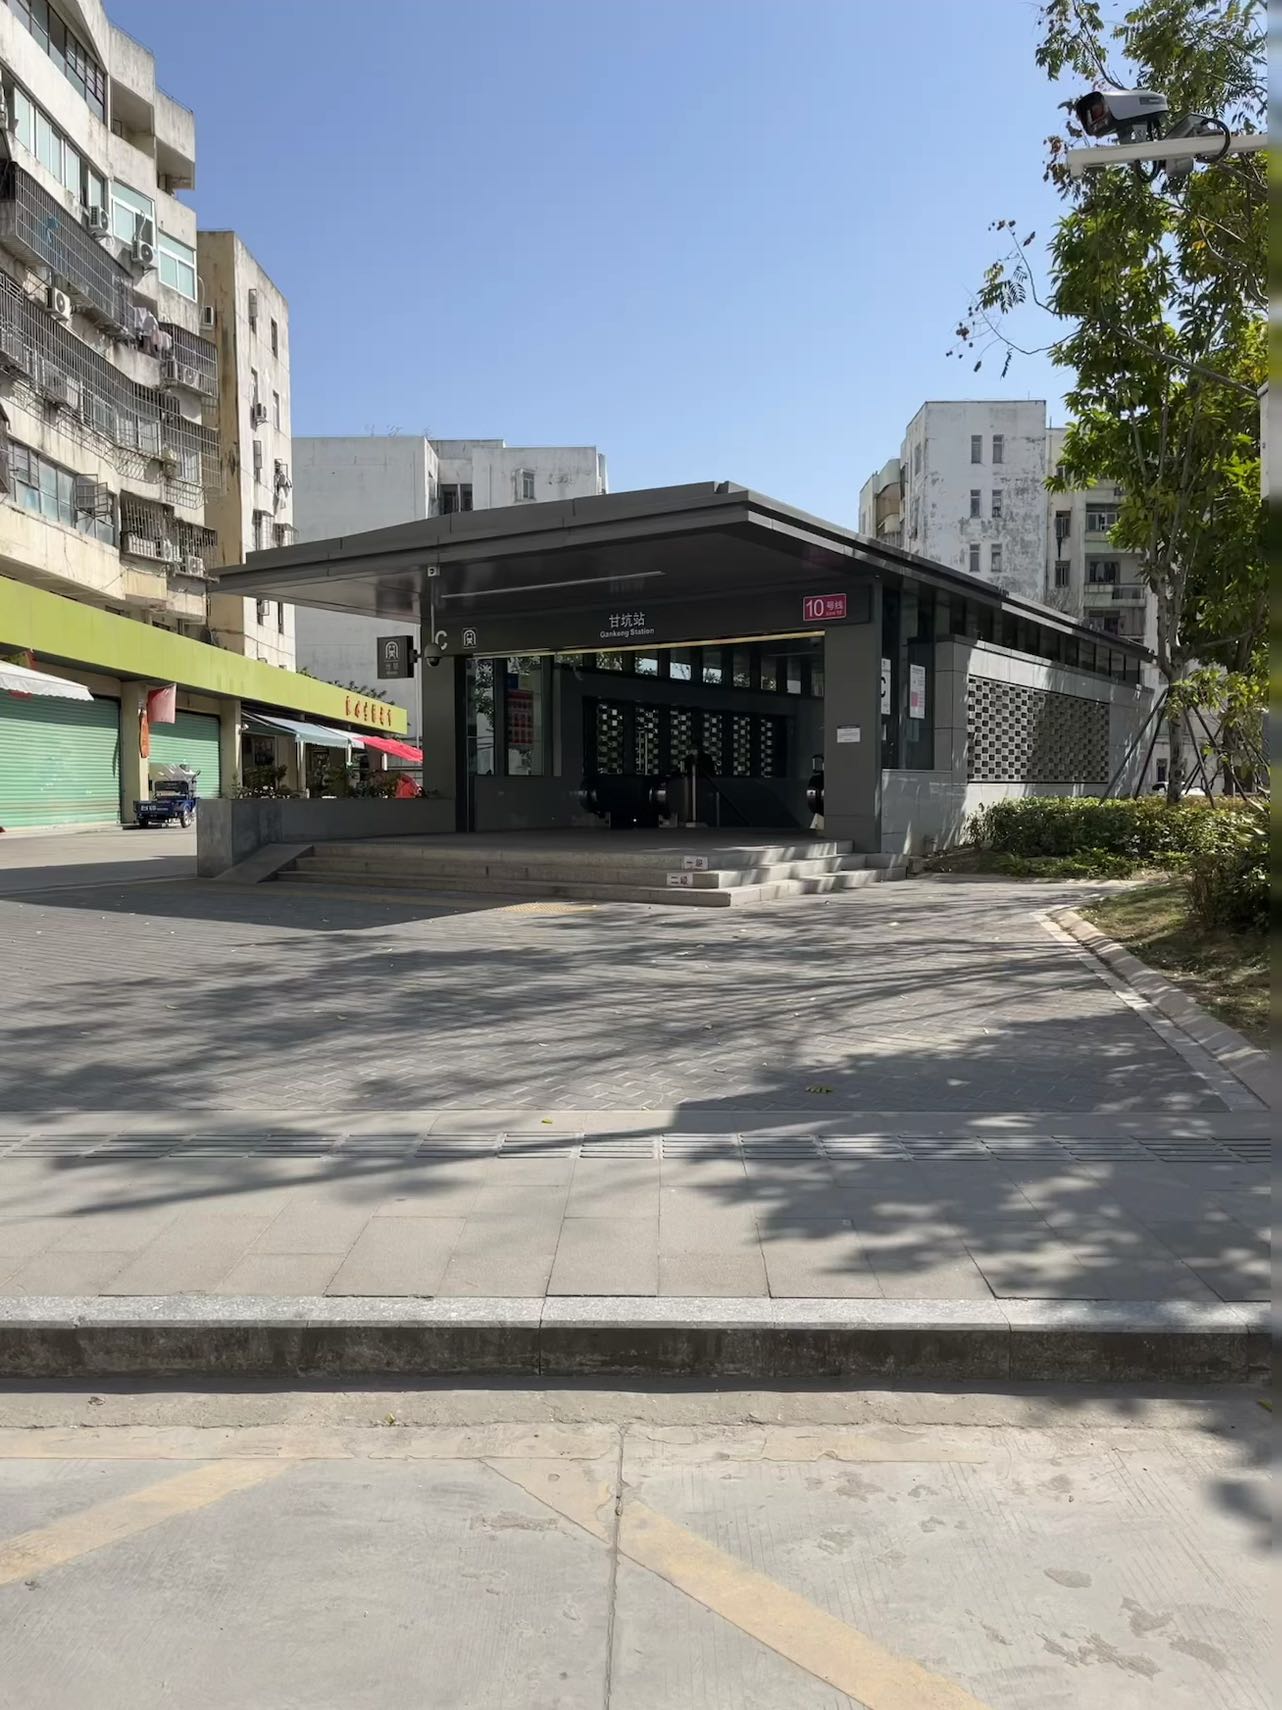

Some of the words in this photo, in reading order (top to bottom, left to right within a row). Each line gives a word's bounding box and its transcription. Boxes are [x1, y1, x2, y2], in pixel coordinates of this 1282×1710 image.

[806, 599, 824, 617] 10
[608, 611, 646, 628] 甘坑站
[435, 630, 448, 650] C
[630, 628, 655, 636] Station
